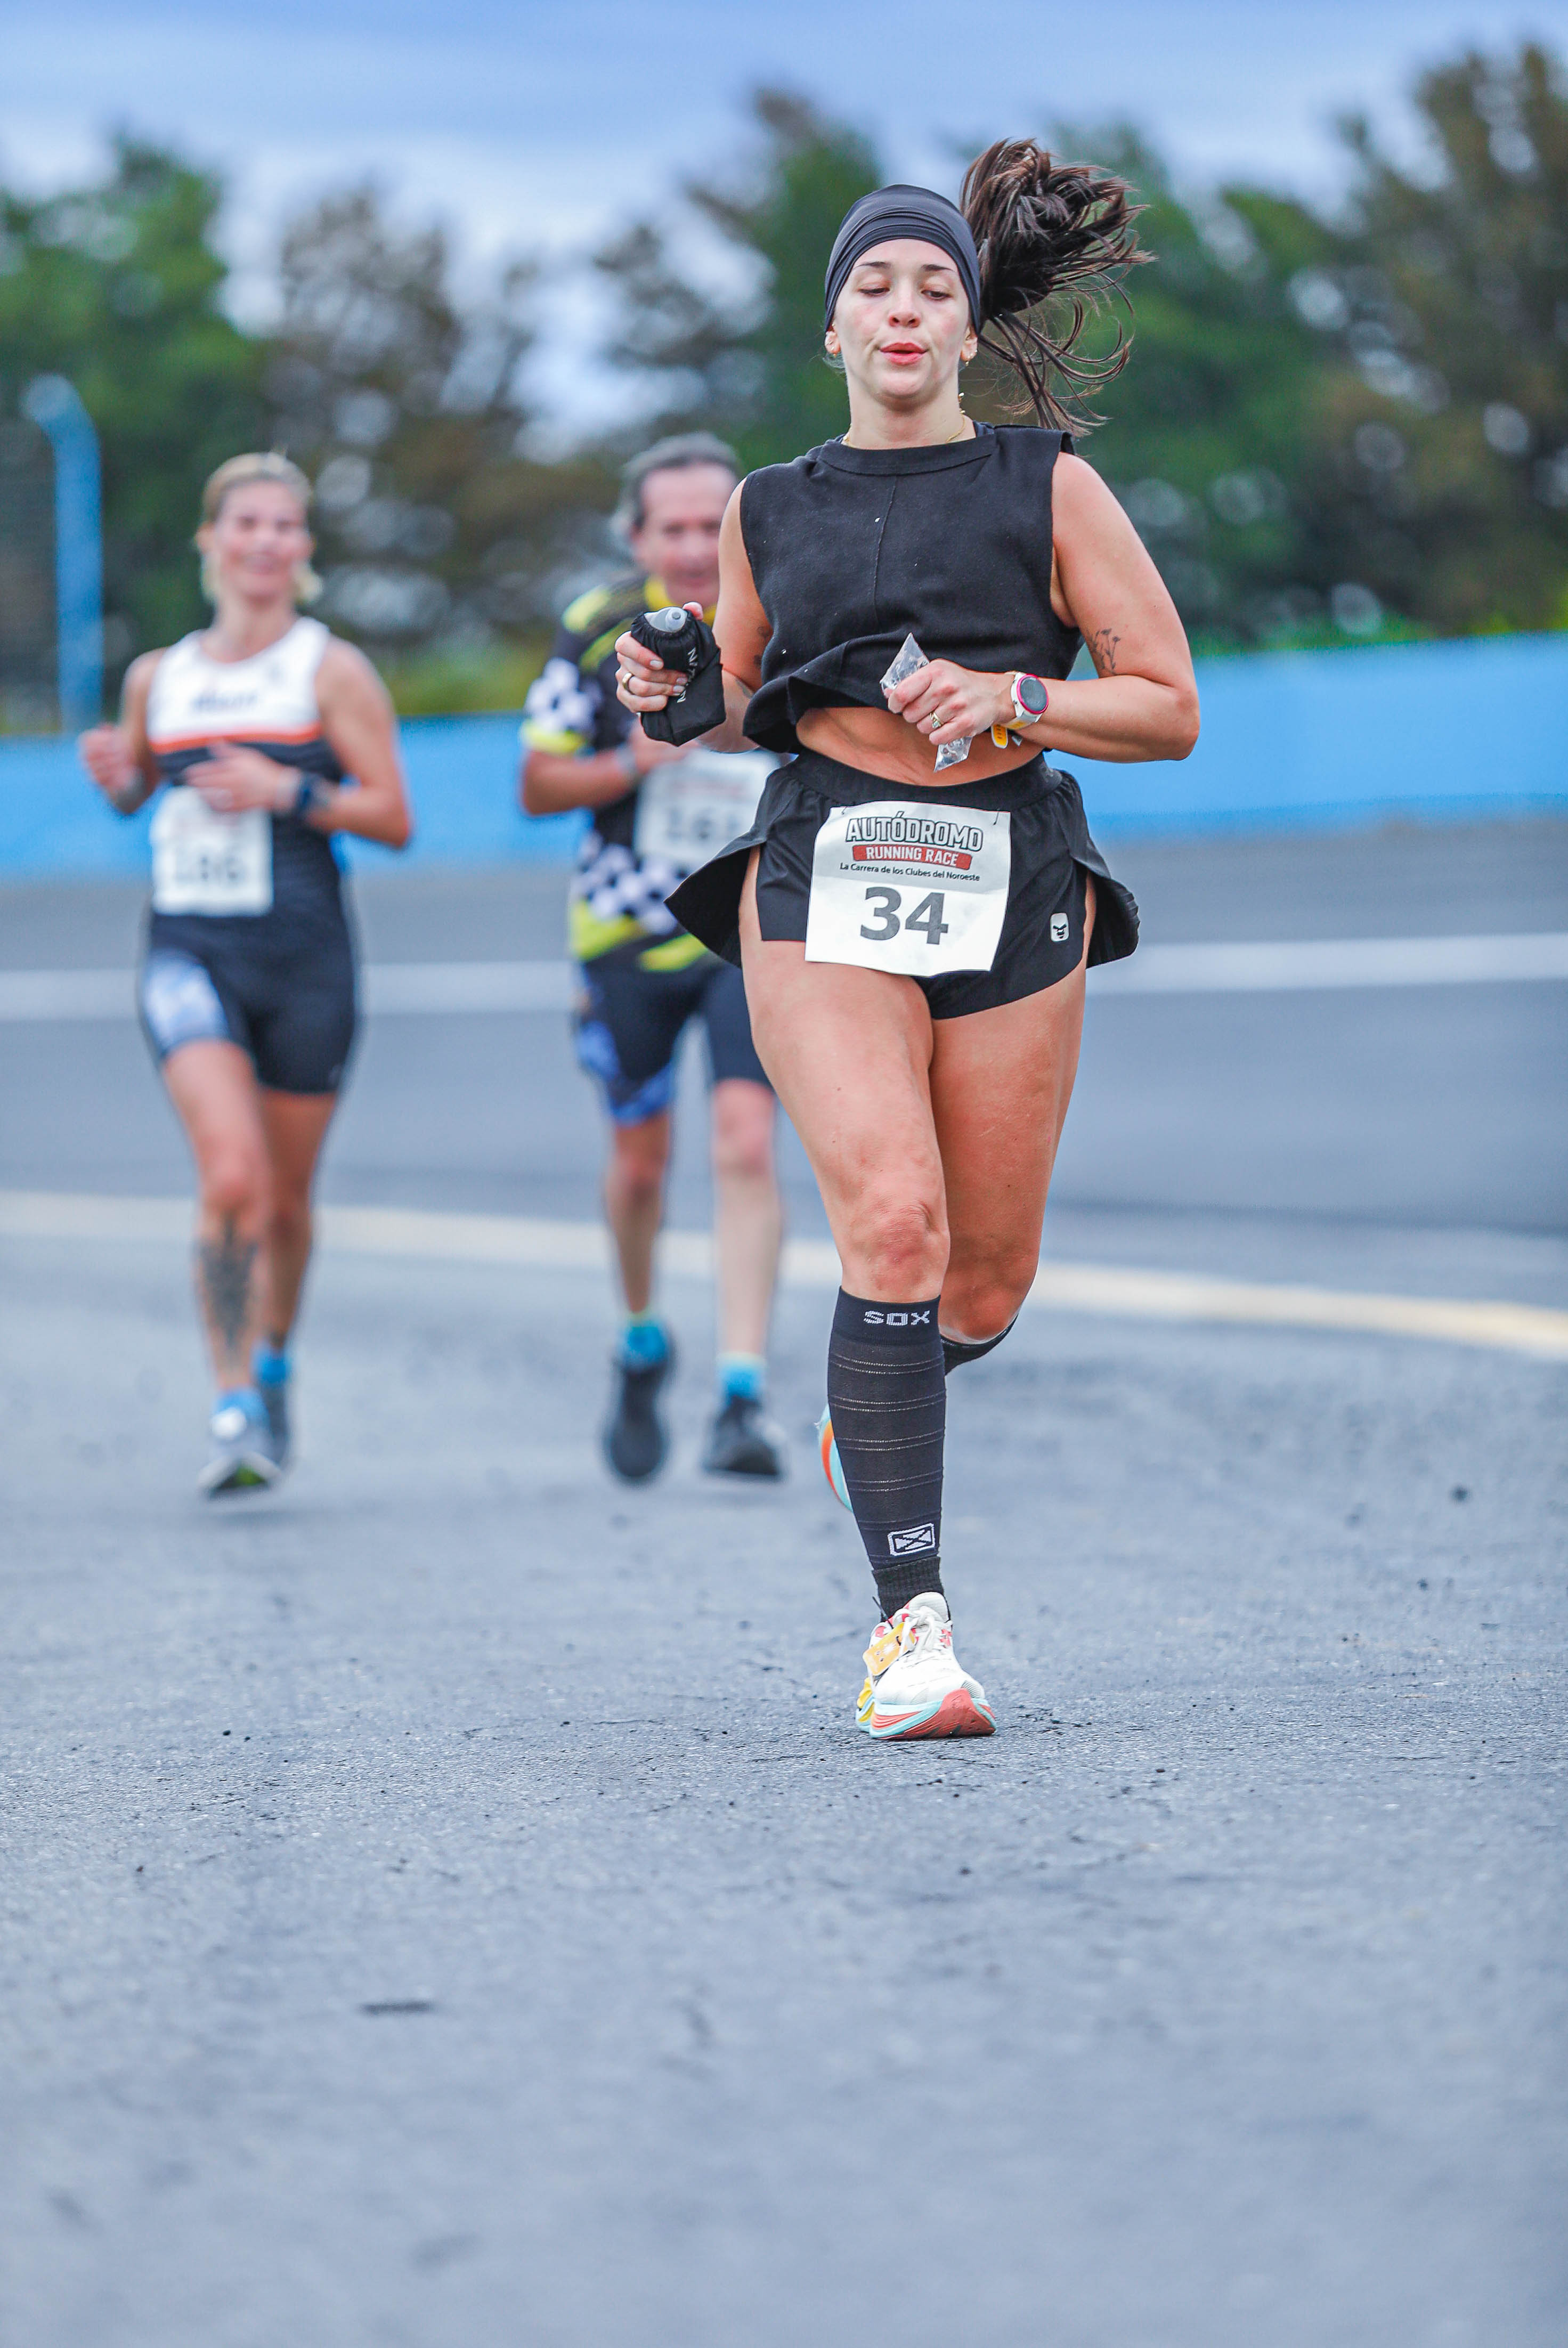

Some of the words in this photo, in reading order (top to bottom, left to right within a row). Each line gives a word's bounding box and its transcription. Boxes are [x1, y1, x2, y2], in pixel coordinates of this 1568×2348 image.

[845, 811, 984, 852] AUTÓDROMO
[865, 846, 922, 860] RUNNING
[925, 849, 959, 866] RACE
[851, 864, 880, 873] Carrera
[905, 868, 931, 878] Clubes
[933, 869, 945, 879] del
[946, 871, 980, 881] Noroeste
[860, 887, 949, 945] 34
[863, 1310, 930, 1326] SOX
